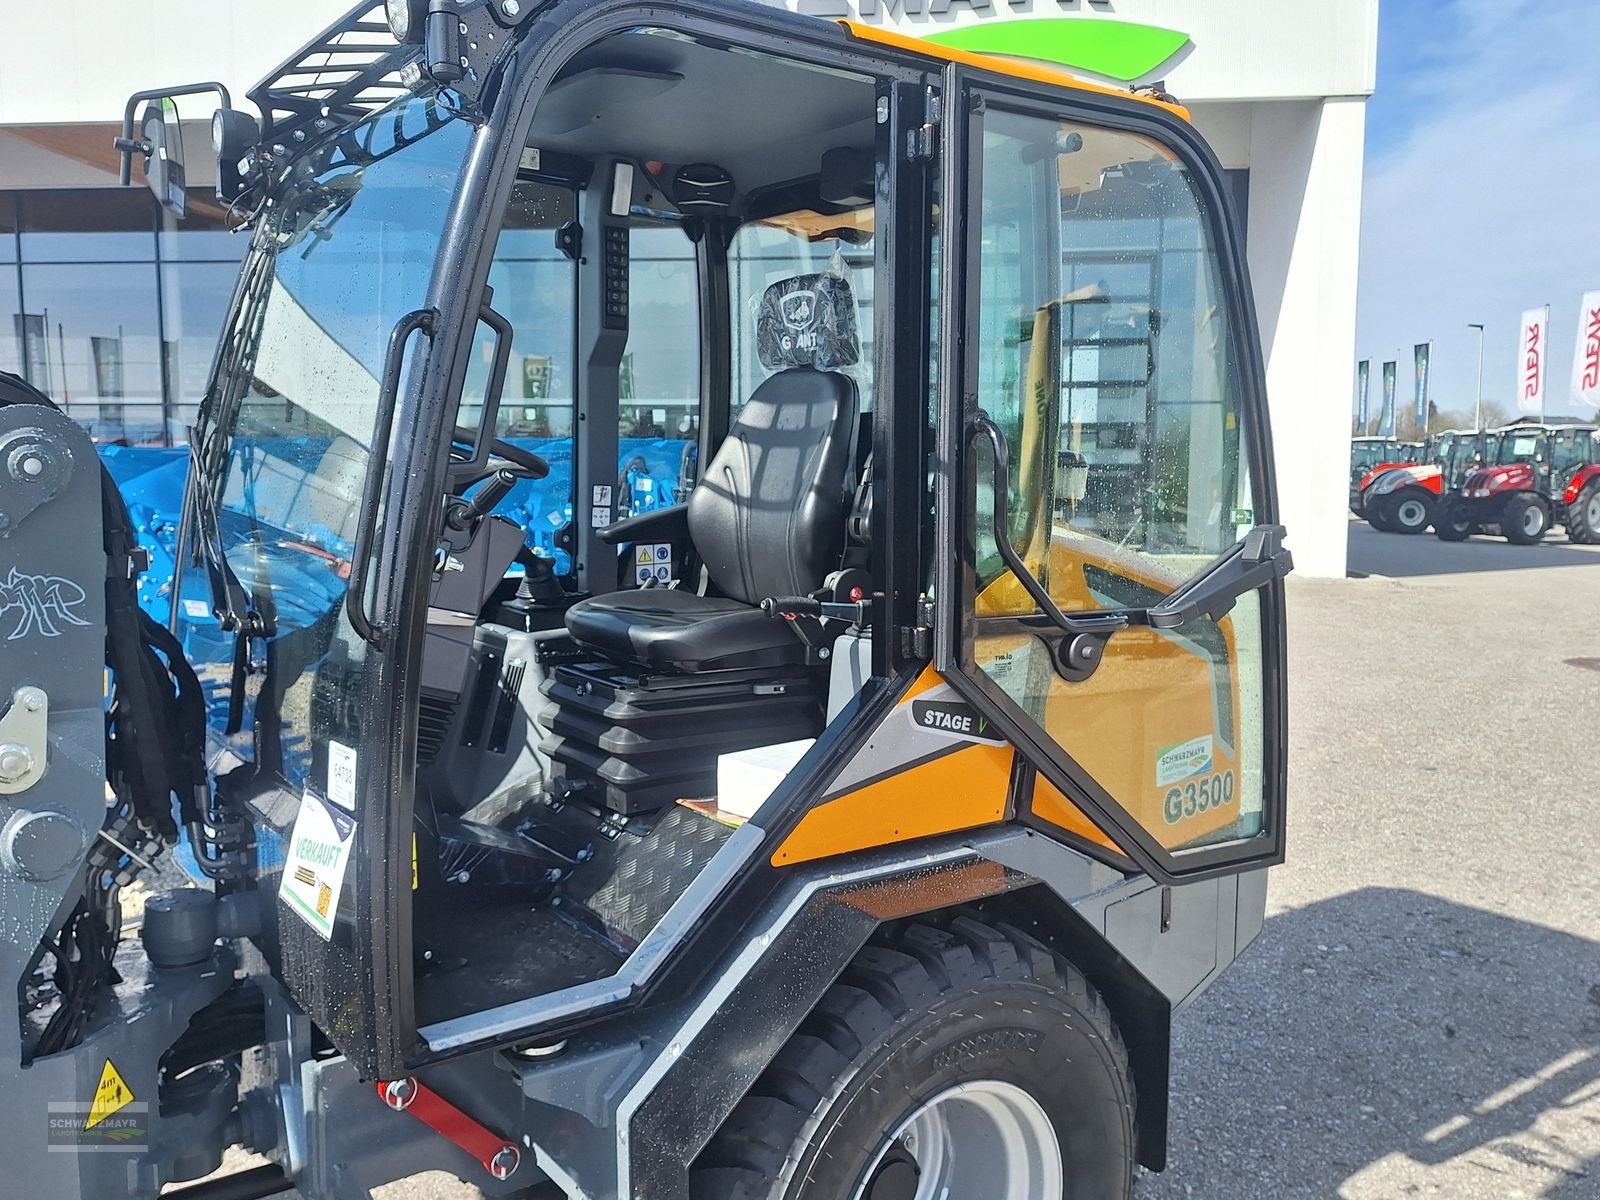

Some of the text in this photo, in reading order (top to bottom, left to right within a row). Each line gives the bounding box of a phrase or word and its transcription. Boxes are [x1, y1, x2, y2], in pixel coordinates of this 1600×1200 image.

[924, 709, 972, 732] STAGE
[1161, 745, 1205, 766] SCHWARZMAYR
[1163, 769, 1234, 823] G3500
[295, 836, 342, 869] VERKAUFT
[100, 1077, 116, 1090] 4m
